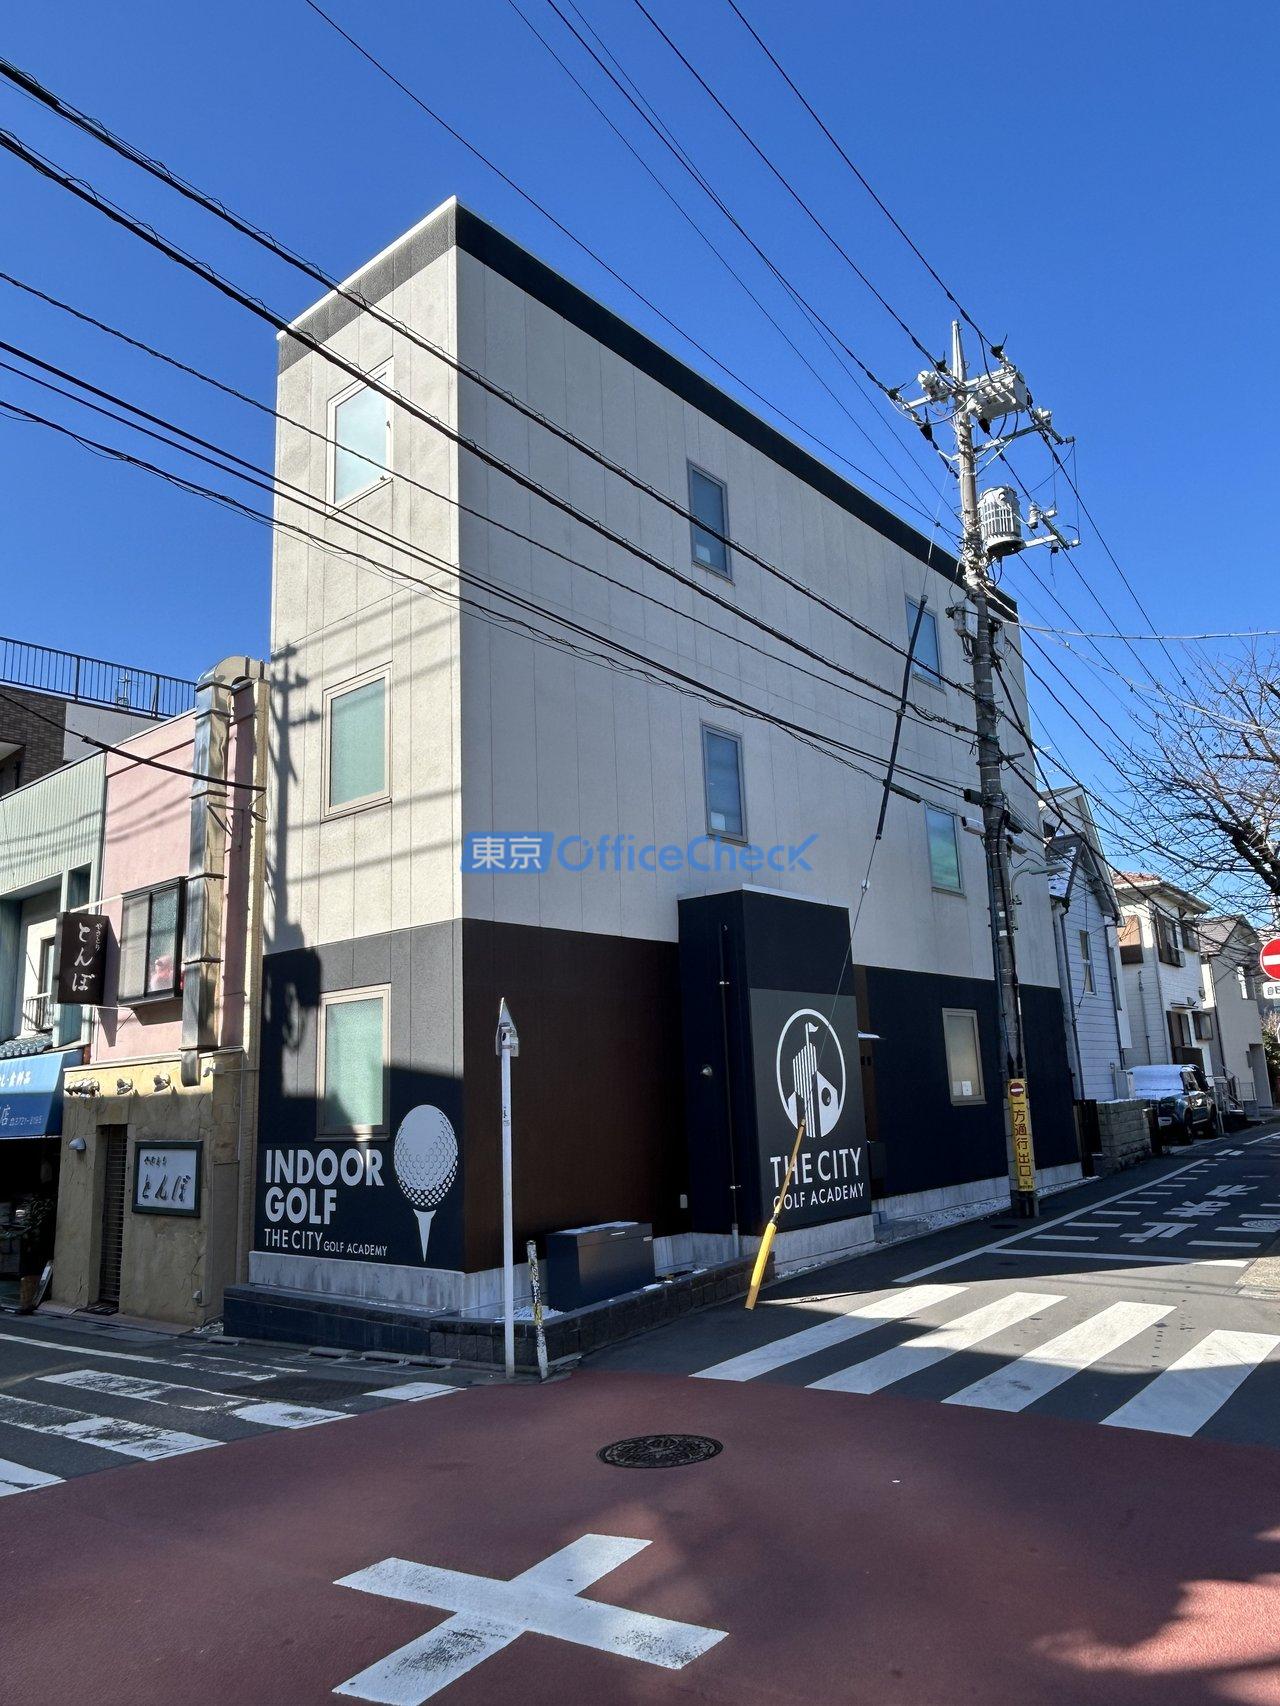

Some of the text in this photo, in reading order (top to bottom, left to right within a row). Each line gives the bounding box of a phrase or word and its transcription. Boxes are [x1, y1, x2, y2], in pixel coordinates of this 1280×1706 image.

[72, 922, 96, 992] とんぼ
[1013, 1101, 1031, 1176] 一方通行出口
[265, 1148, 385, 1187] INDOOR
[770, 1147, 862, 1188] THE CITY
[142, 1173, 191, 1202] とんぼ
[264, 1187, 337, 1225] GOLF
[811, 1183, 865, 1206] ACADEMY
[264, 1229, 388, 1257] THE CITY GOLF ACADEMY
